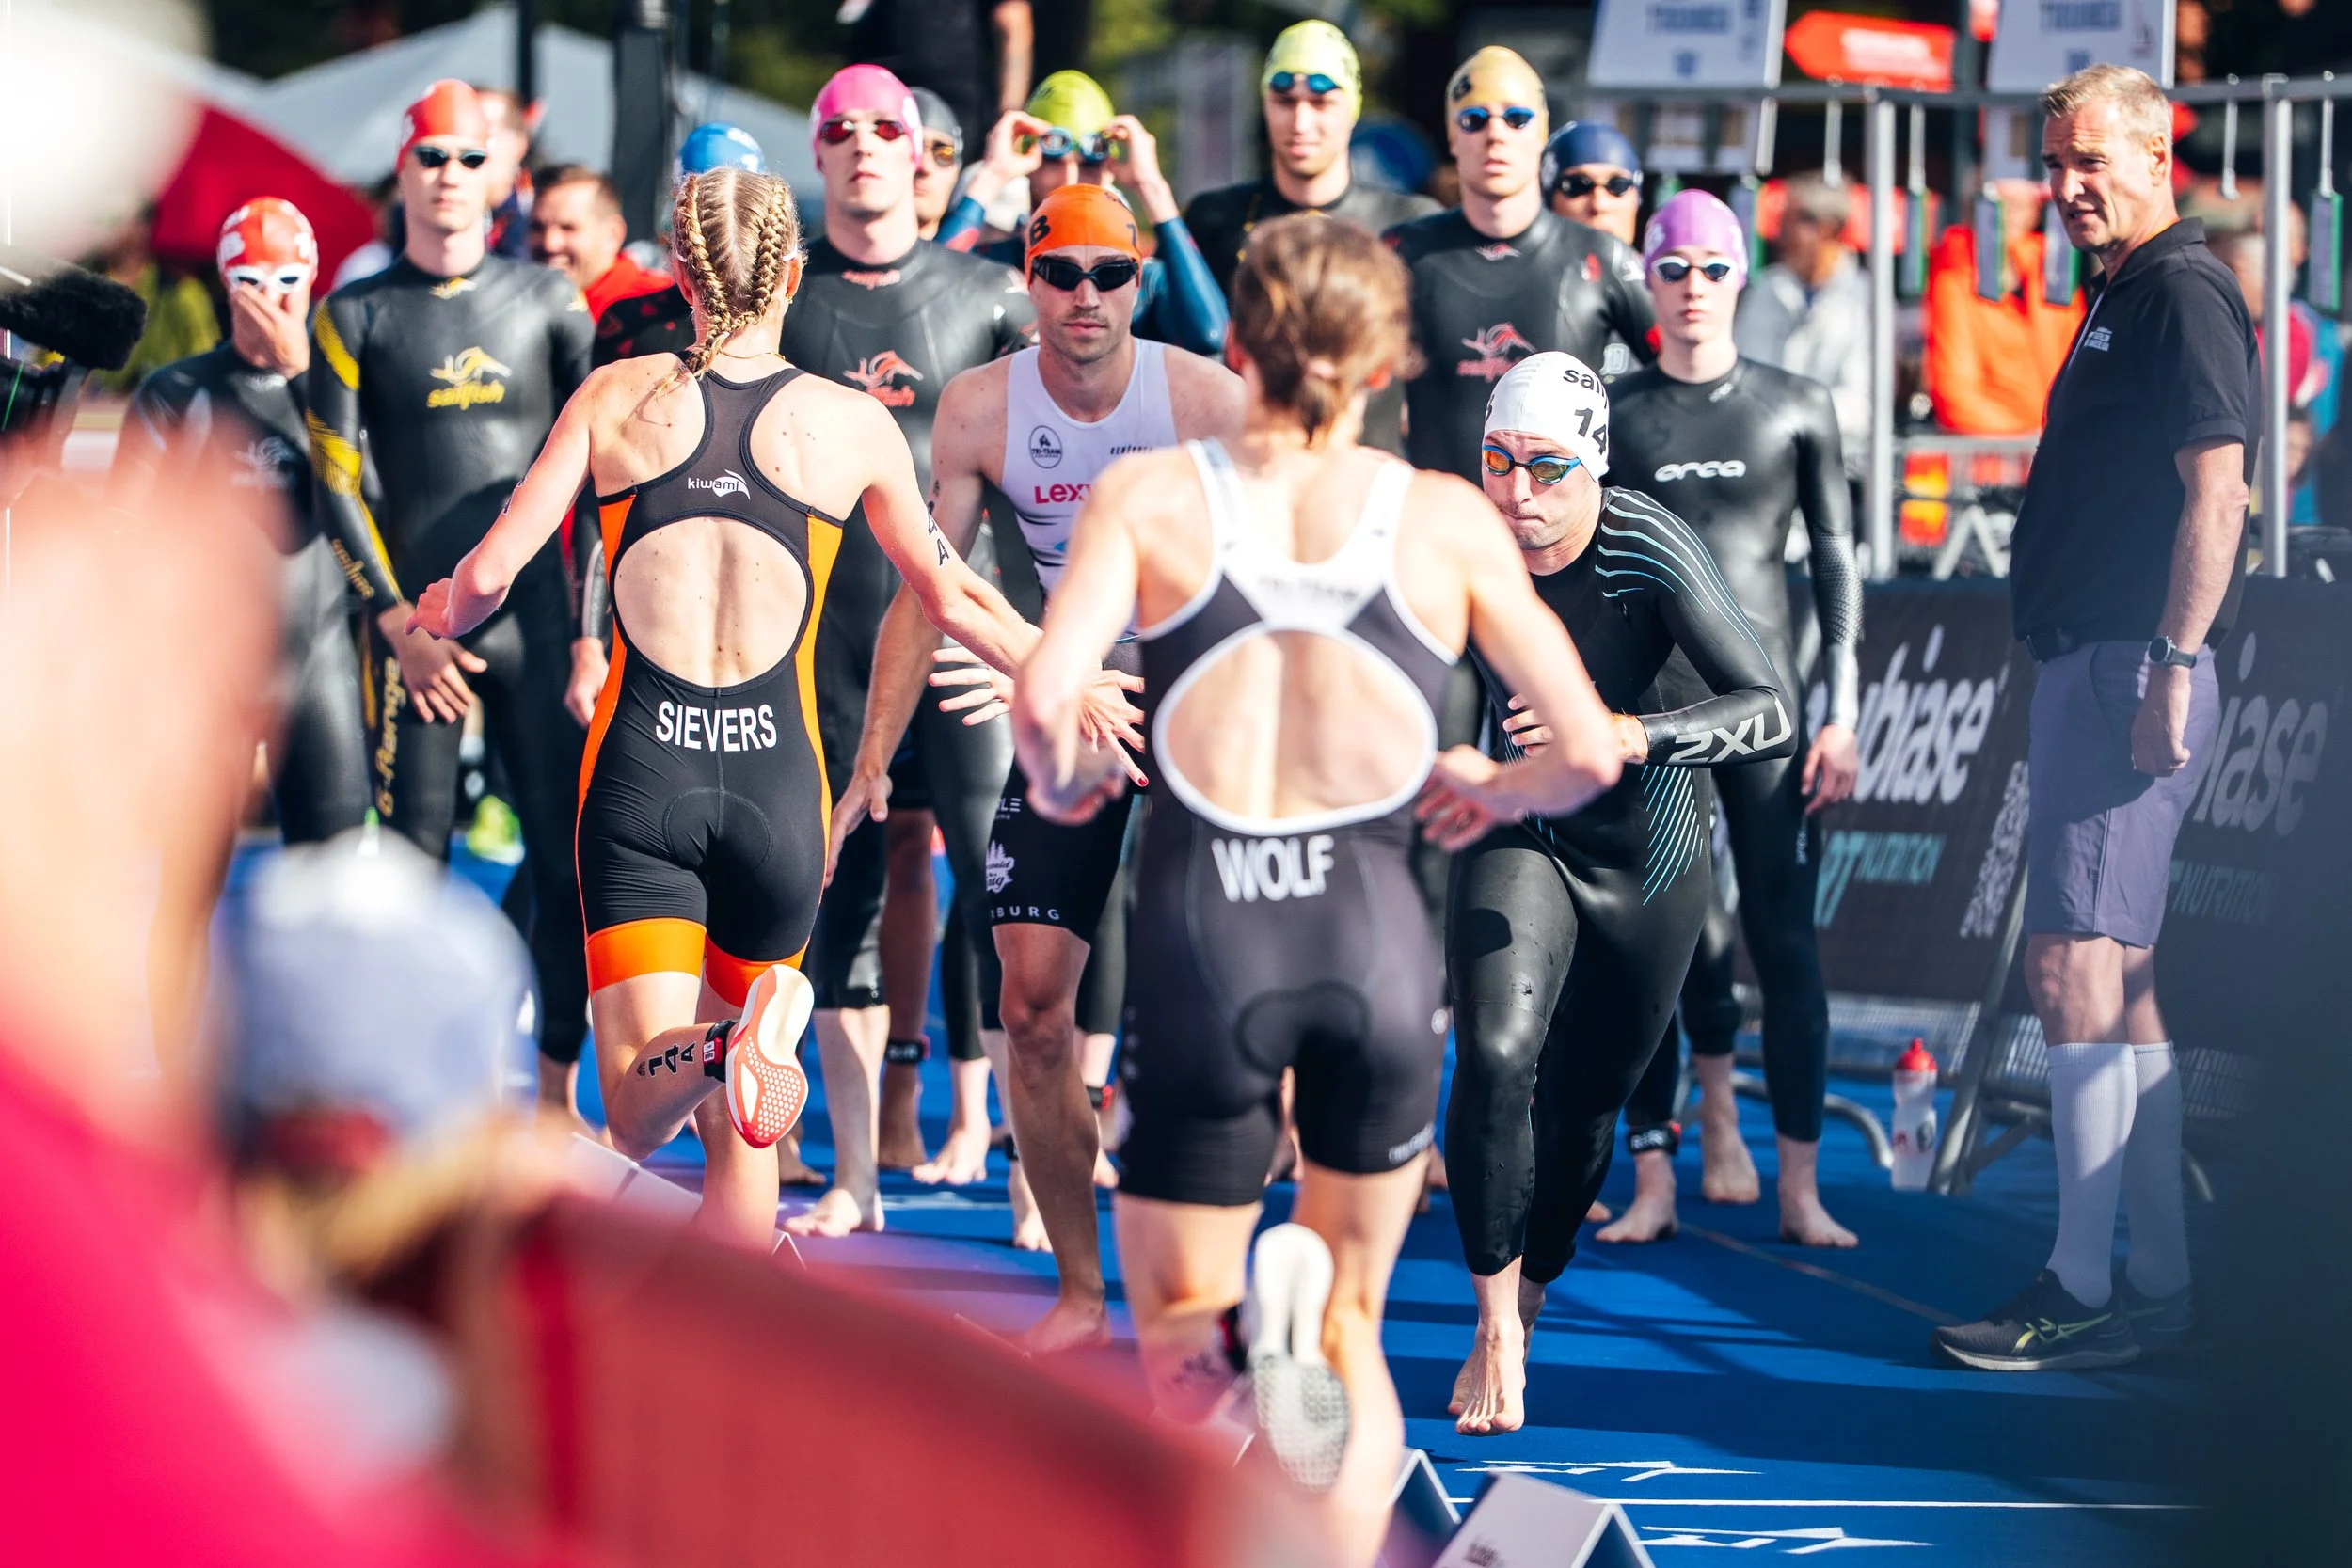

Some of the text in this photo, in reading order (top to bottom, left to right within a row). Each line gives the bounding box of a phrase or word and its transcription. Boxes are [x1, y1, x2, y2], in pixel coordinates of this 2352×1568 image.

[1574, 407, 1607, 455] 14
[688, 475, 742, 494] kiwami
[1654, 459, 1747, 482] orca
[655, 700, 777, 752] SIEVERS
[1665, 697, 1792, 764] 2XU
[1211, 834, 1335, 903] WOLF
